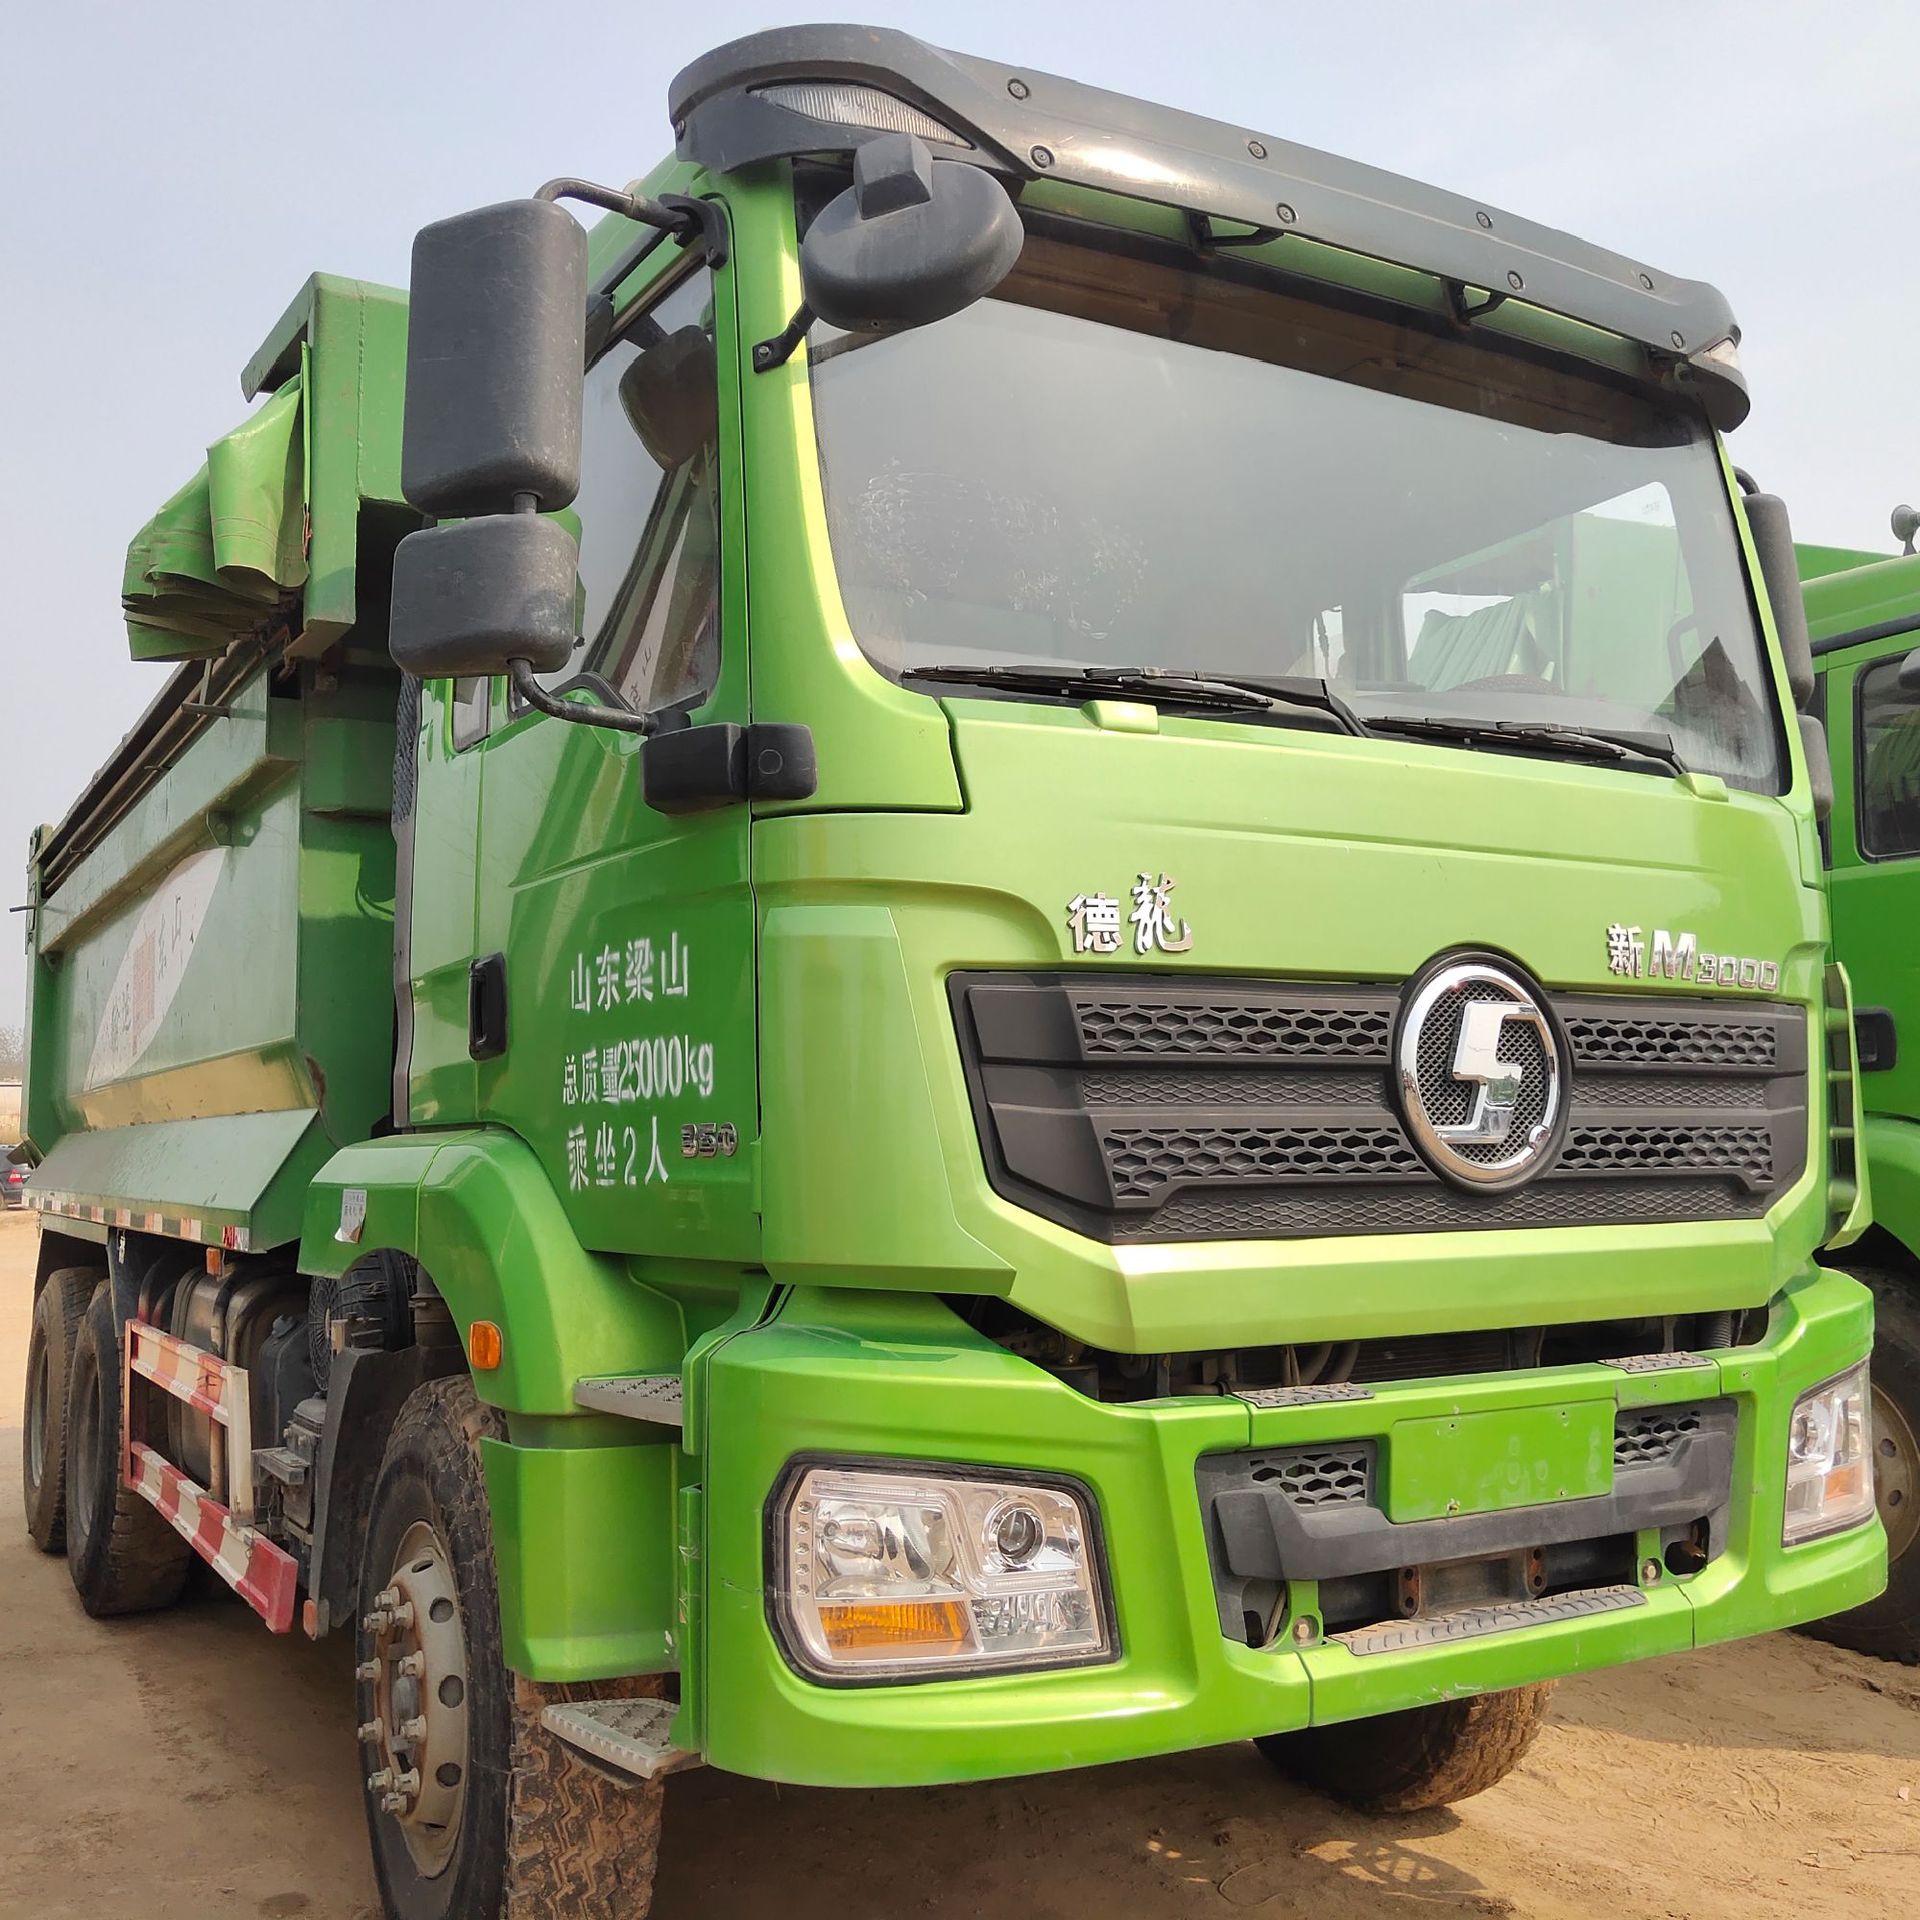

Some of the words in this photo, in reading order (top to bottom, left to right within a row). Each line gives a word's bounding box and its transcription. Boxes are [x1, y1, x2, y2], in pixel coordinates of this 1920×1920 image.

[570, 931, 688, 1014] 山东梁山
[563, 1035, 714, 1105] 总质量25000kg
[567, 1115, 669, 1191] 乘坐2人
[681, 1121, 739, 1158] 350
